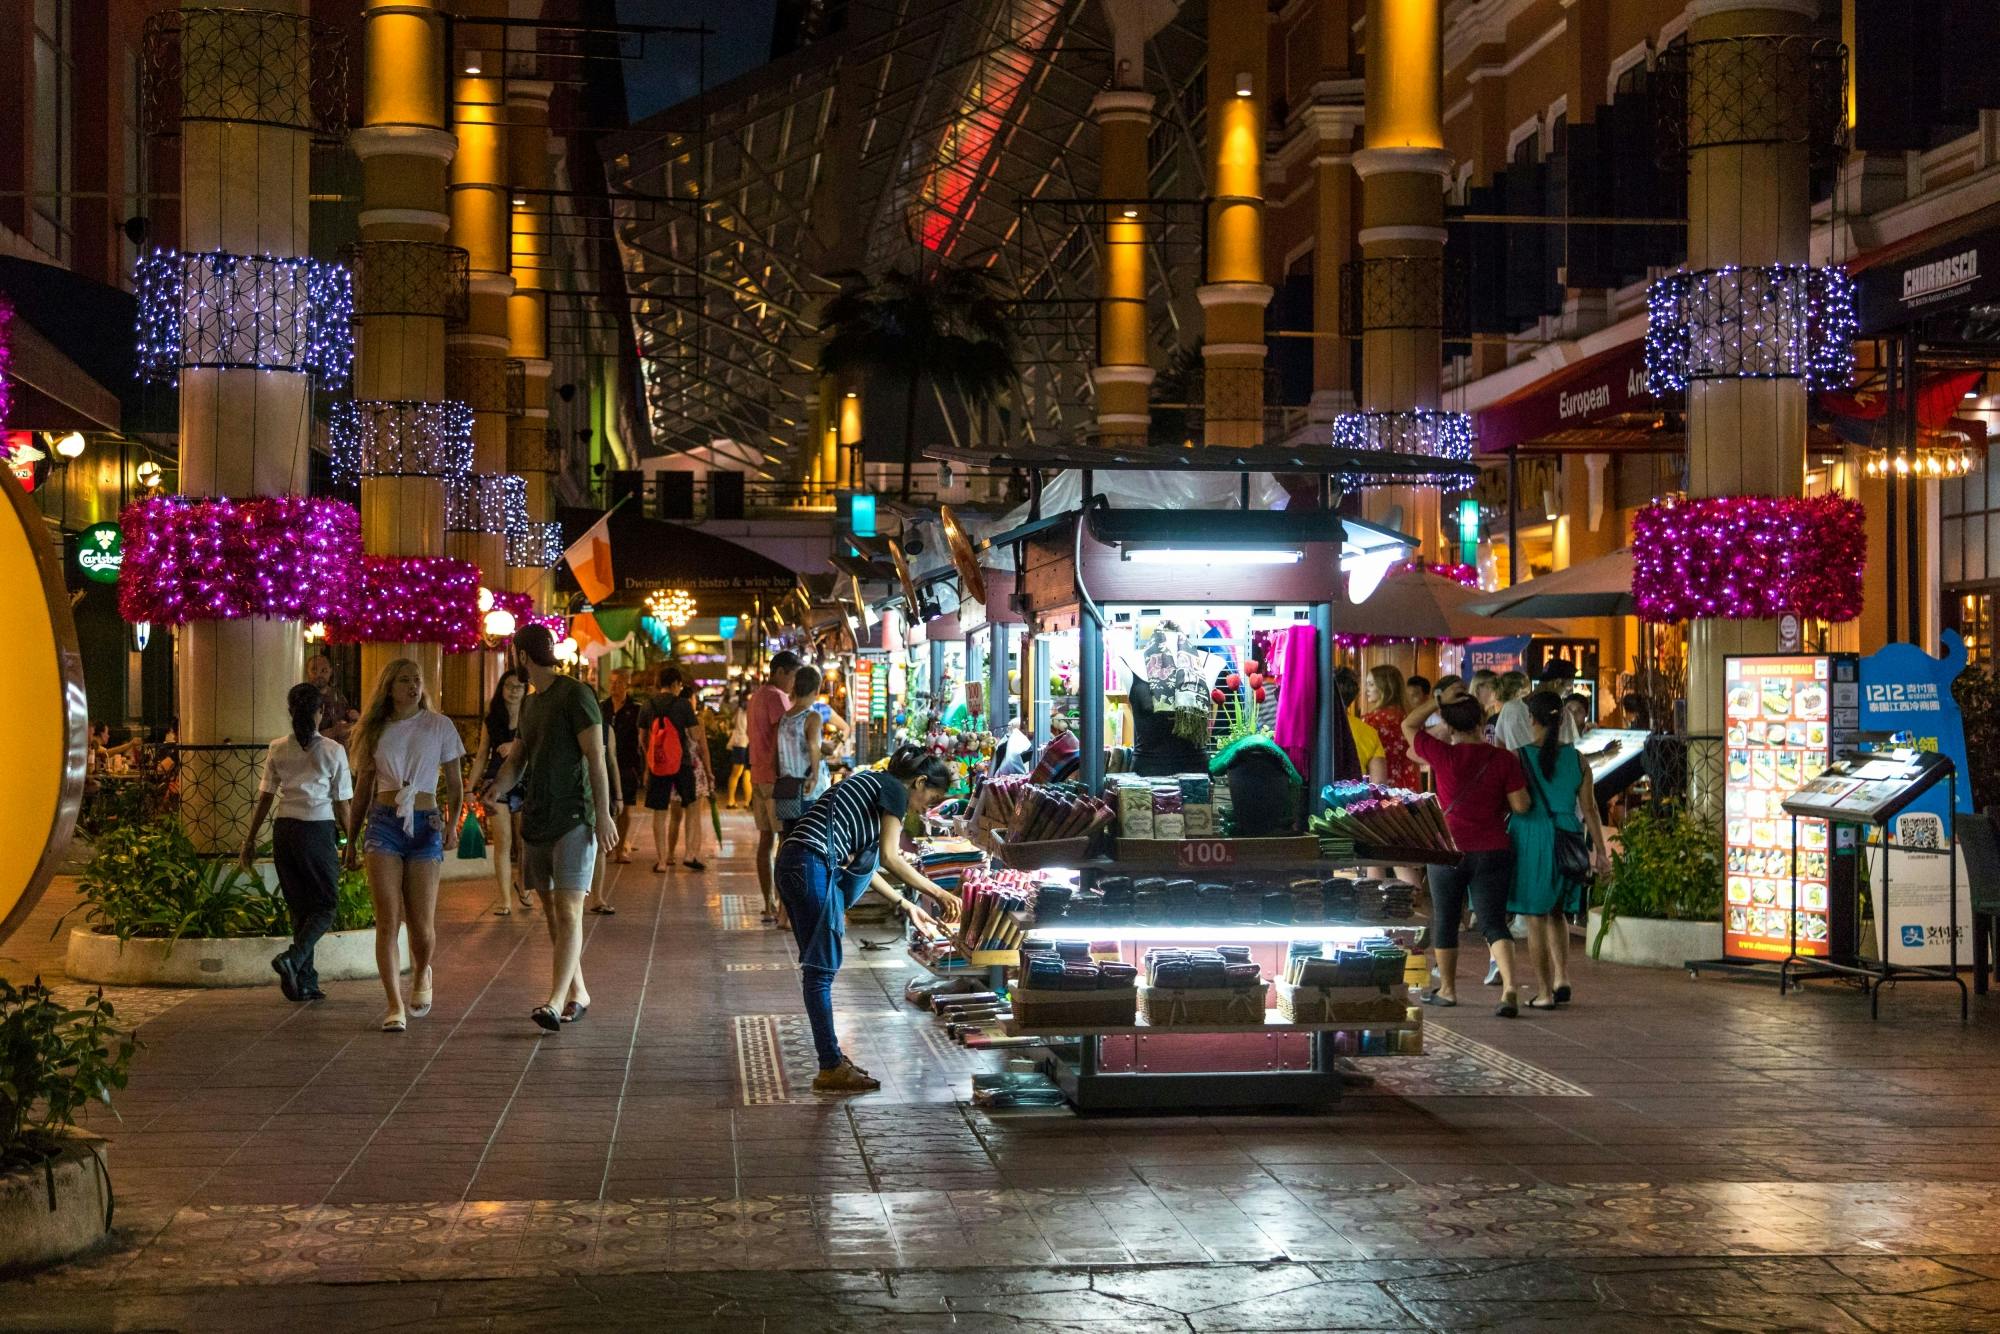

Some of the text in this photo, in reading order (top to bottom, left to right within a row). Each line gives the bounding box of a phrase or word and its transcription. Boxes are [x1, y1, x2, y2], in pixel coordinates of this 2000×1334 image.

[1903, 249, 1977, 298] CHURRASCO
[1560, 384, 1610, 419] European
[698, 576, 729, 588] bistro
[744, 576, 771, 587] wine
[773, 576, 791, 586] bar
[1471, 652, 1494, 664] 1212
[1543, 645, 1584, 669] EAT
[1782, 664, 1813, 674] SPECIALS
[1866, 684, 1905, 701] 1212
[1183, 842, 1226, 863] 100
